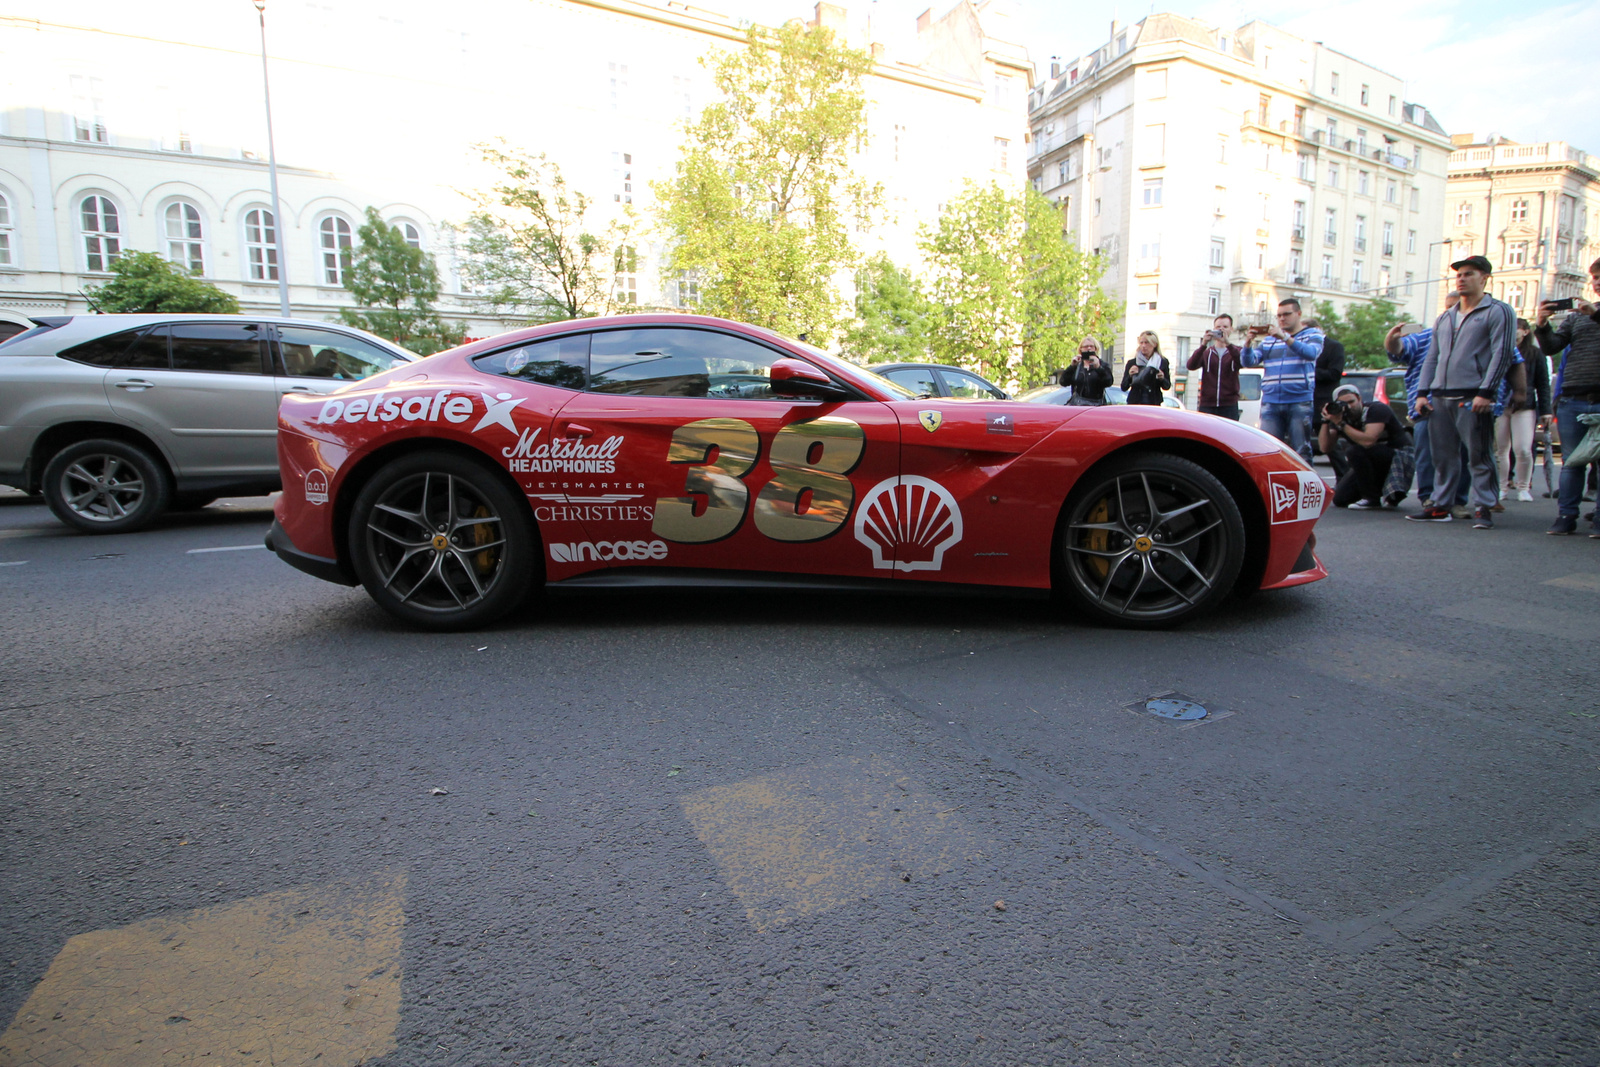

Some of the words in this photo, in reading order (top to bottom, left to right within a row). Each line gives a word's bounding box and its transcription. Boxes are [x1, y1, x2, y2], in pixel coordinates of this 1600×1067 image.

[317, 390, 473, 424] betsafe
[502, 427, 624, 459] Marshall
[509, 459, 616, 474] HEADPHONES
[651, 416, 867, 545] 38
[1303, 481, 1322, 494] NEW
[1302, 495, 1321, 509] ERA
[534, 506, 654, 522] CHRISTIE'S
[570, 540, 668, 562] incase
